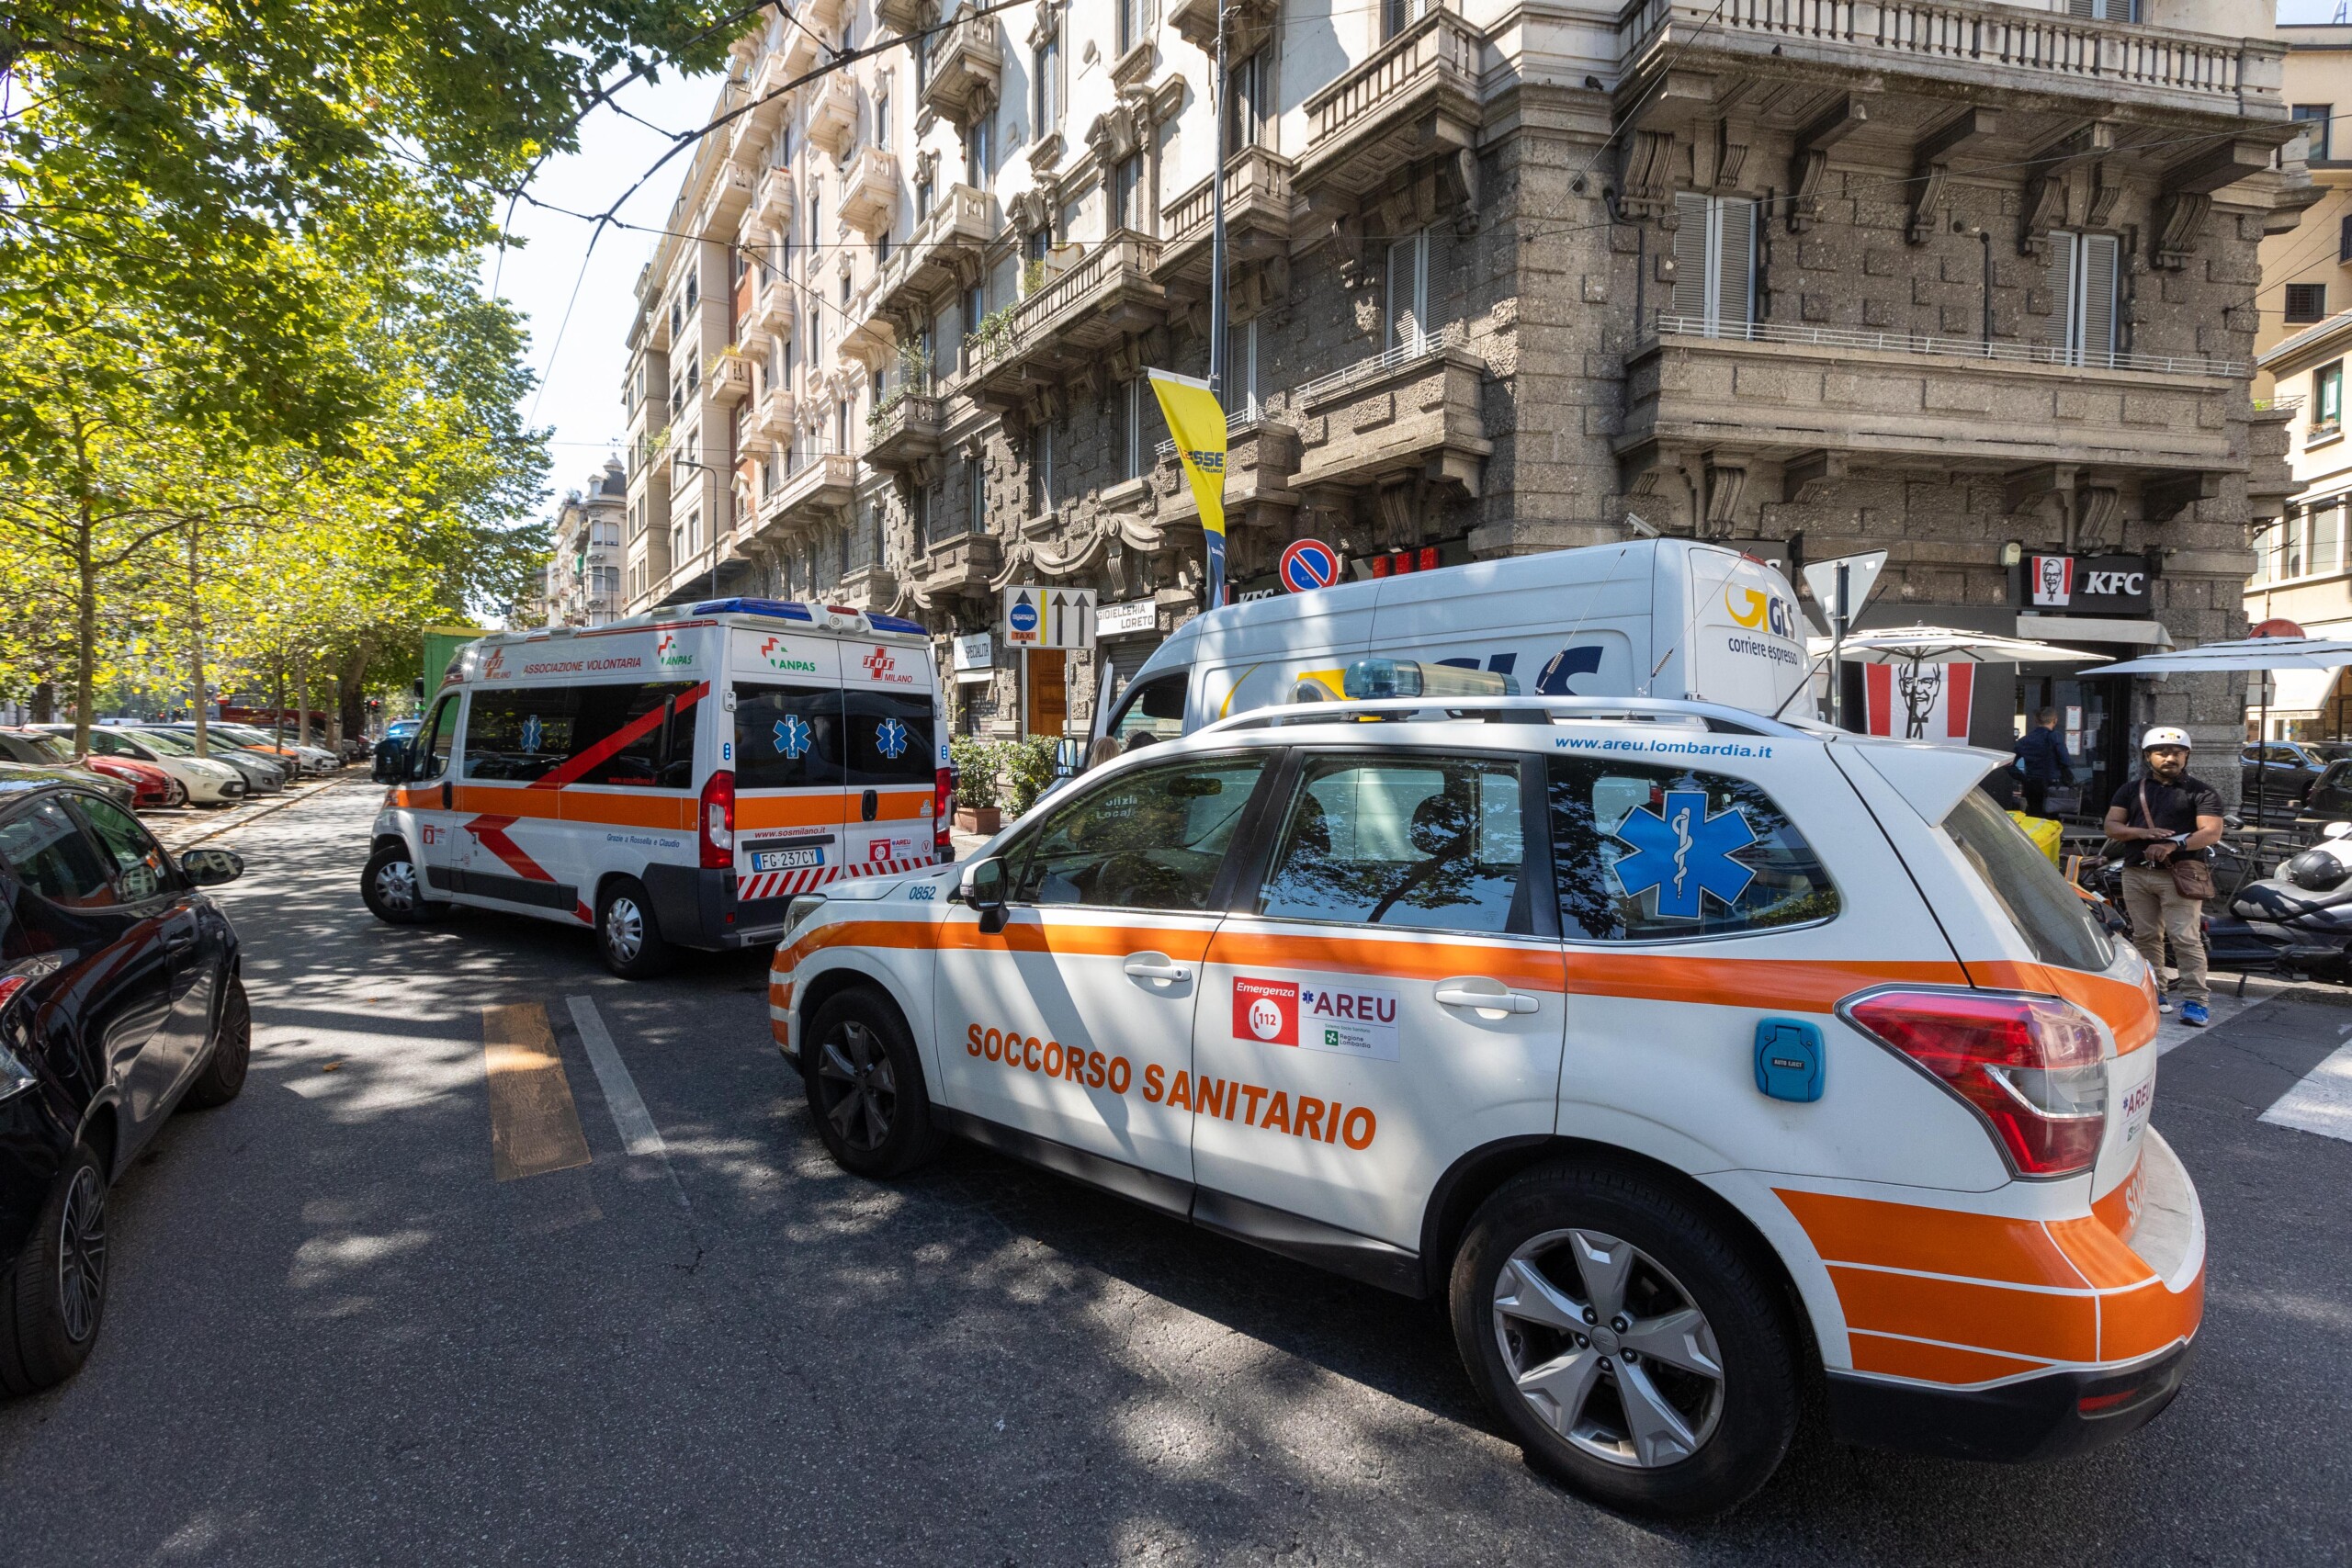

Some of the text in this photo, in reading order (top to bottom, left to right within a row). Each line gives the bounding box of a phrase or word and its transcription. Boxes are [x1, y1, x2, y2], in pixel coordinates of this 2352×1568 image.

[2085, 571, 2144, 595] KFC
[1098, 604, 1146, 620] GIOIELLERIA
[1121, 615, 1154, 629] LORETO
[1014, 632, 1035, 640] TAXI
[1728, 636, 1798, 666] corriere espresso
[523, 657, 641, 674] ASSOCIAZIONE VOLONTARIA
[666, 655, 693, 666] ANPAS
[779, 660, 816, 671] ANPAS
[884, 673, 913, 682] MILANO
[1555, 738, 1772, 759] www.areu.lombardia.it
[1105, 795, 1138, 807] olizia
[754, 826, 826, 839] www.sosmilano.it
[606, 833, 624, 842] Grazie
[629, 836, 651, 845] Rossella
[659, 839, 680, 848] Claudio
[762, 851, 815, 868] FG 237CY
[909, 886, 936, 900] 0852
[1237, 982, 1295, 998] Emergenza
[1314, 991, 1396, 1023] AREU
[1259, 1012, 1276, 1026] 112
[1340, 1032, 1364, 1042] Regione
[1340, 1039, 1372, 1049] Lombardia
[967, 1022, 1377, 1151] SOCCORSO SANITARIO
[2127, 1078, 2153, 1118] AREU
